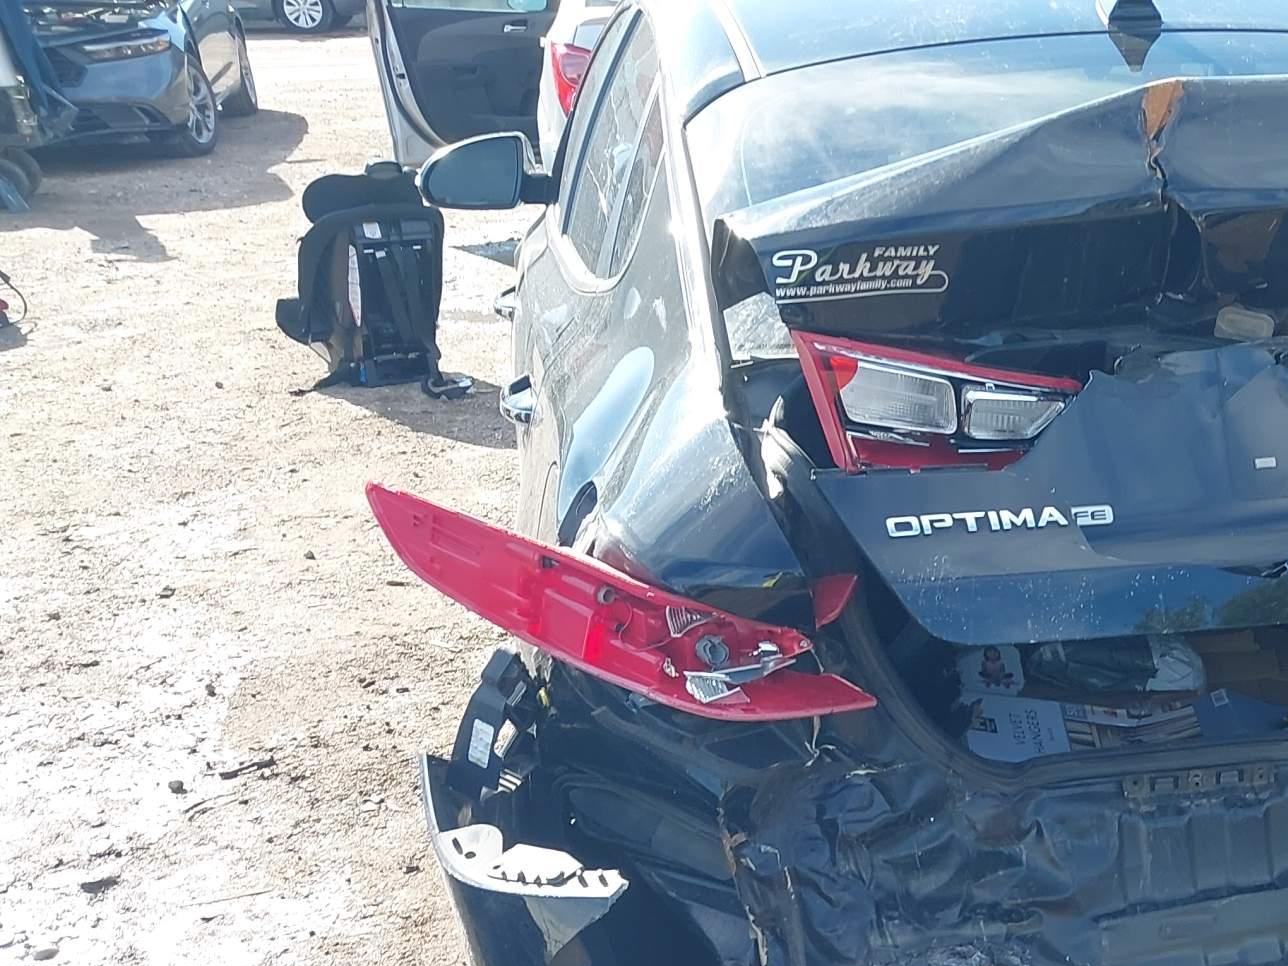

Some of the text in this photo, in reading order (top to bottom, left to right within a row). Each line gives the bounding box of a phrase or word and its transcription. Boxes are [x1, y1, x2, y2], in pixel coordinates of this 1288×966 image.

[873, 244, 940, 258] FAMILY
[772, 249, 937, 286] Parkway
[775, 278, 912, 297] www.parkwayfamily.com
[885, 506, 1069, 537] OPTIMA
